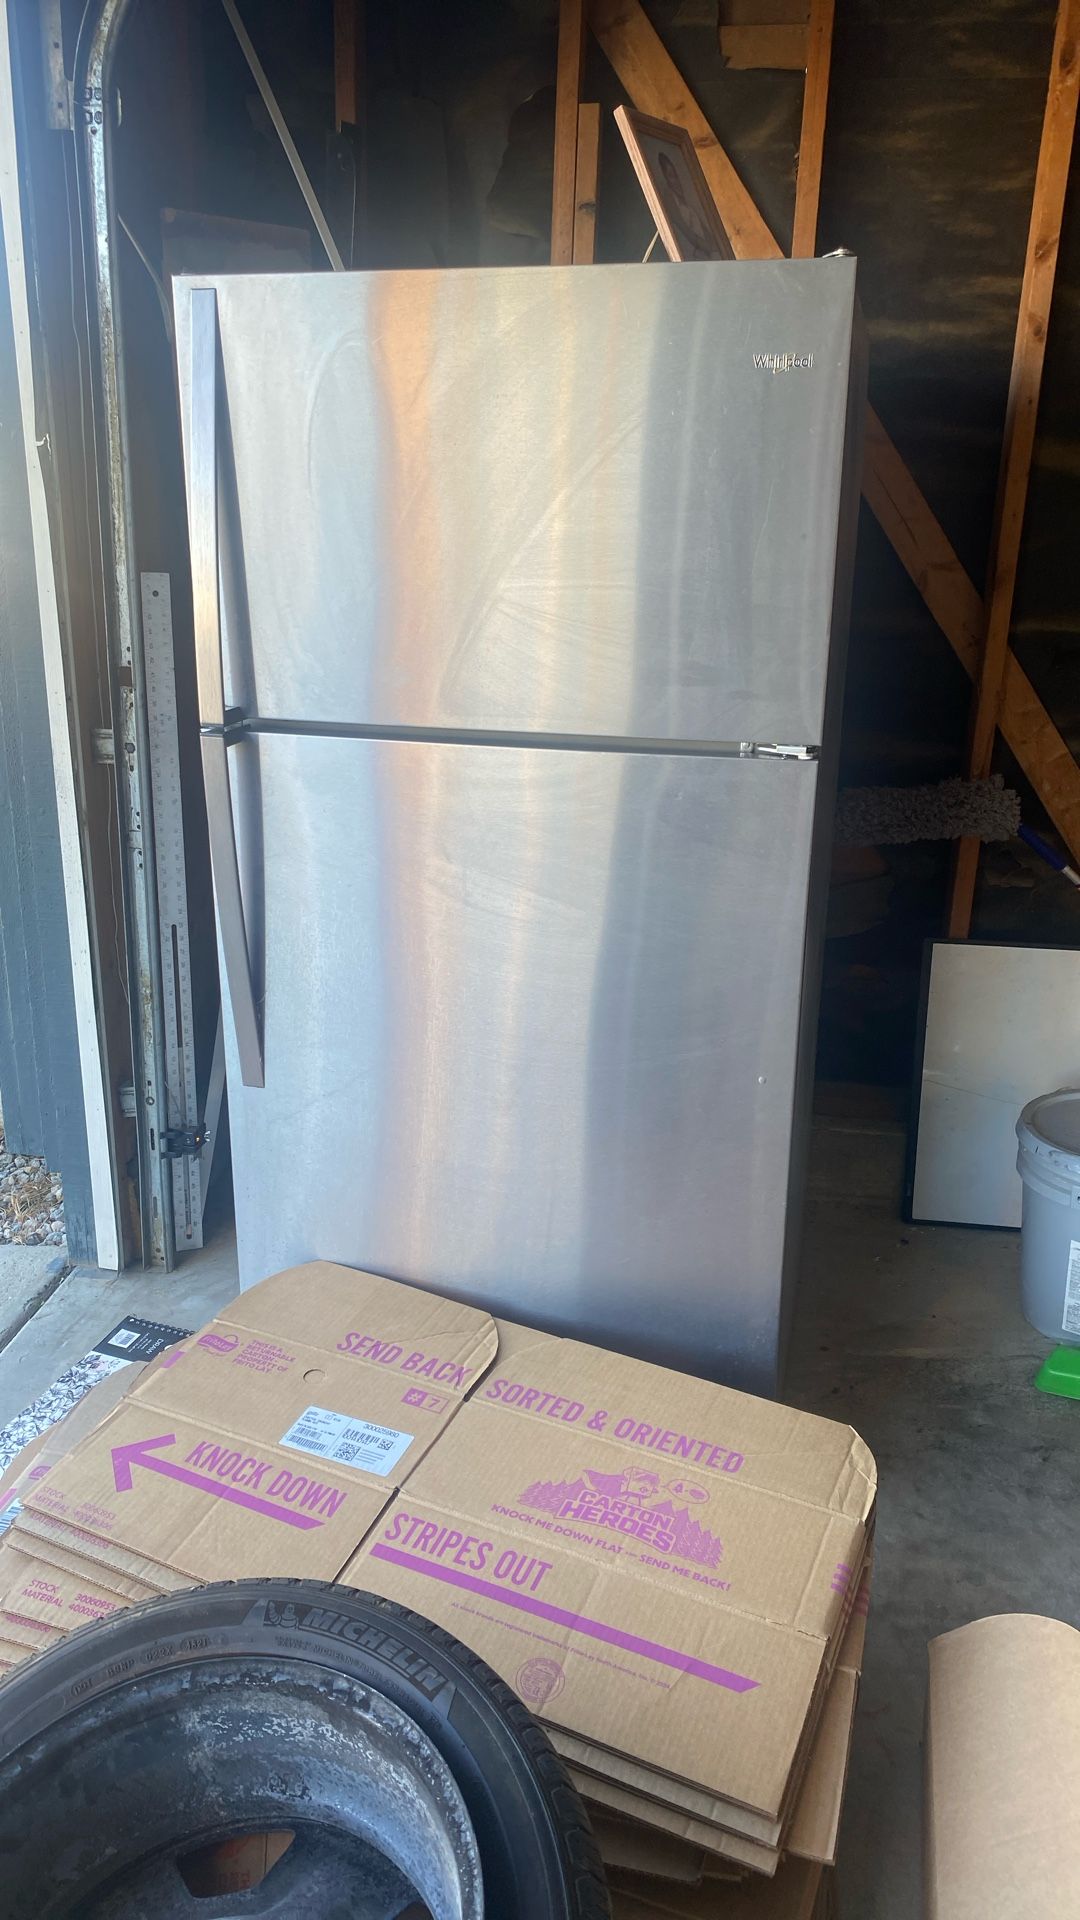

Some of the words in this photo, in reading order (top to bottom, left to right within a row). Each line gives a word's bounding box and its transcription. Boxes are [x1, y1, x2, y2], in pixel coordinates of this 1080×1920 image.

[753, 353, 814, 374] Whirlpool
[336, 1331, 403, 1364] SEND
[400, 1352, 473, 1391] BACK
[486, 1379, 585, 1422] SORTED
[586, 1410, 608, 1431] &
[614, 1418, 745, 1473] ORIENTED
[185, 1440, 273, 1490] KNOCK
[265, 1470, 348, 1518] DOWN
[558, 1501, 675, 1552] HEROES
[579, 1490, 674, 1530] CARTON
[385, 1513, 494, 1570] STRIPES
[493, 1551, 553, 1592] OUT
[491, 1503, 534, 1524] KNOCK
[535, 1517, 554, 1530] ME
[553, 1524, 593, 1544] DOWN
[595, 1539, 624, 1554] FLAT
[639, 1554, 671, 1571] SEND
[672, 1566, 691, 1579] ME
[692, 1572, 732, 1592] BACK!
[22, 1589, 64, 1607] MATERIAL
[29, 1579, 59, 1593] STOCK
[302, 1607, 448, 1691] MICHELIN
